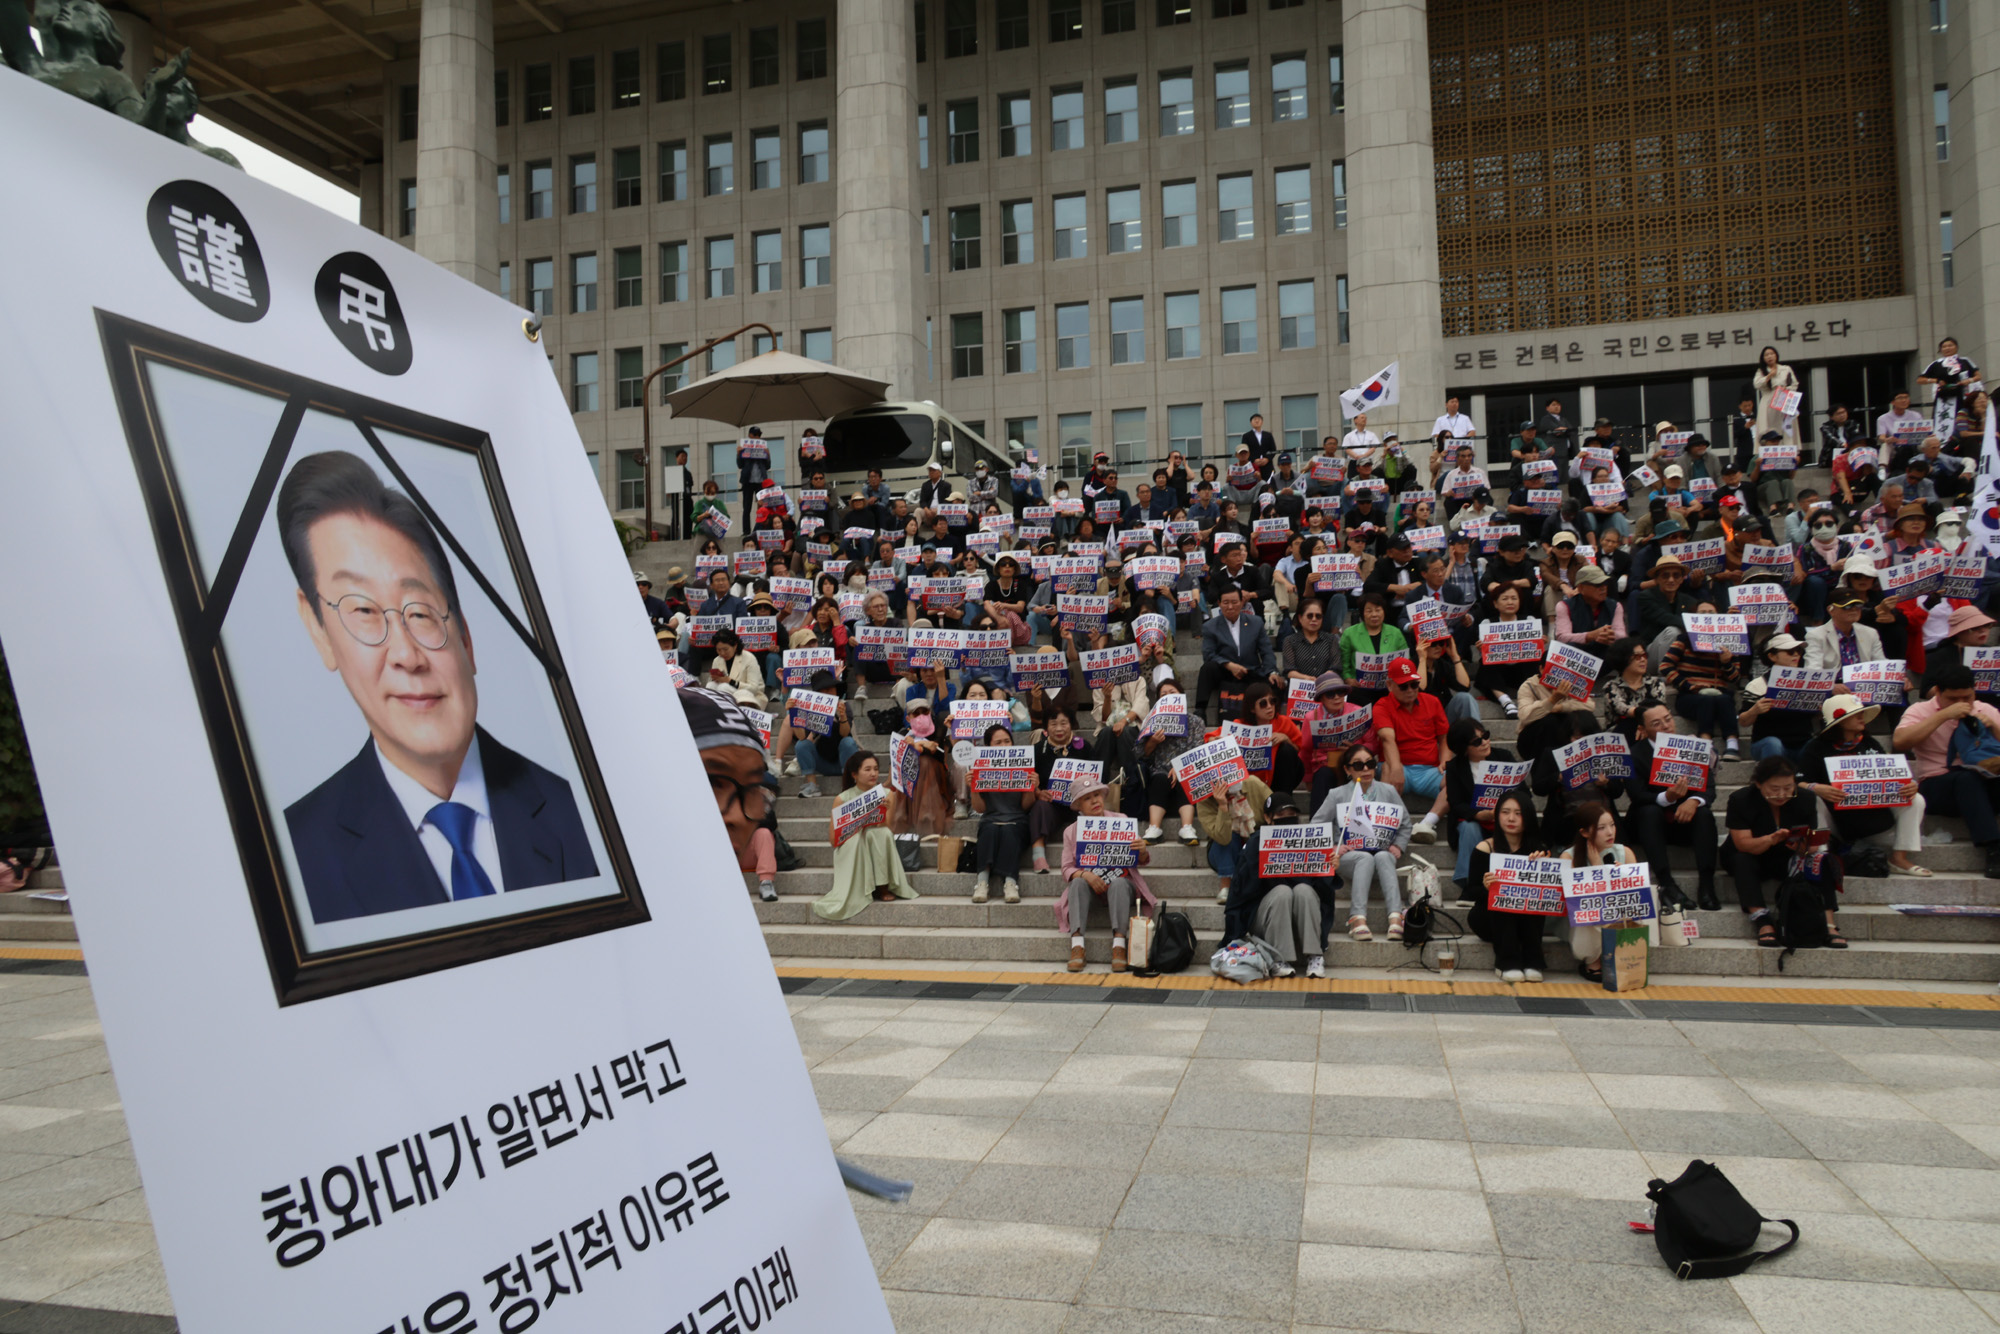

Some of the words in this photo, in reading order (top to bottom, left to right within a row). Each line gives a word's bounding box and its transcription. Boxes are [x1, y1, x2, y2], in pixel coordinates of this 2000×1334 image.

[168, 204, 258, 307] 謹
[339, 271, 396, 353] 弔
[1454, 350, 1497, 370] 모든
[1516, 342, 1584, 366] 권력은
[1604, 328, 1753, 358] 국민으로부터
[1774, 319, 1851, 343] 나온다
[1488, 623, 1517, 633] 피하지
[1518, 622, 1532, 630] 말고
[912, 638, 934, 646] 진실을
[936, 639, 958, 647] 밝혀라
[1482, 633, 1499, 642] 재판
[1500, 632, 1516, 640] 부터
[1517, 629, 1540, 639] 받아라
[915, 649, 928, 657] 518
[930, 649, 953, 658] 유공자
[1488, 642, 1520, 652] 국민합의
[1521, 641, 1536, 650] 없는
[910, 657, 925, 666] 전면
[980, 657, 1007, 666] 공개하라
[1485, 652, 1509, 662] 개헌은
[1509, 650, 1541, 660] 반대한다
[1558, 646, 1582, 662] 피하지
[1580, 655, 1595, 668] 말고
[1549, 653, 1566, 666] 재판
[1564, 659, 1580, 672] 부터
[1577, 664, 1597, 679] 받아라
[1548, 665, 1576, 684] 국민합의
[1574, 676, 1588, 689] 없는
[954, 728, 972, 736] 전면
[980, 749, 1006, 758] 피하지
[1008, 749, 1024, 757] 말고
[1180, 748, 1207, 766] 피하지
[1206, 740, 1226, 755] 말고
[1564, 746, 1592, 767] 진실을
[1595, 744, 1626, 755] 밝혀라
[973, 758, 989, 767] 재판
[991, 758, 1007, 767] 부터
[1008, 758, 1032, 766] 받아라
[1178, 765, 1196, 778] 재판
[1194, 757, 1213, 772] 부터
[1211, 746, 1238, 764] 받아라
[1573, 762, 1591, 776] 518
[1592, 757, 1623, 770] 유공자
[1838, 757, 1872, 769] 피하지
[1875, 756, 1896, 768] 말고
[978, 770, 1010, 779] 국민합의
[1012, 770, 1027, 779] 없는
[1187, 767, 1220, 789] 국민합의
[1218, 759, 1238, 775] 없는
[1483, 772, 1508, 784] 진실을
[1570, 772, 1590, 787] 전면
[1832, 770, 1855, 780] 재판
[1855, 768, 1877, 779] 부터
[1877, 767, 1907, 778] 받아라
[975, 780, 998, 789] 개헌은
[999, 779, 1031, 788] 반대한다
[1841, 782, 1882, 795] 국민합의
[1883, 781, 1903, 792] 없는
[1189, 782, 1214, 801] 개헌은
[1484, 788, 1502, 798] 518
[841, 798, 864, 814] 피하지
[864, 791, 878, 804] 말고
[1478, 798, 1497, 808] 전면
[836, 814, 850, 827] 재판
[851, 806, 867, 820] 부터
[1082, 830, 1107, 840] 진실을
[1111, 830, 1135, 840] 밝혀라
[1272, 827, 1302, 838] 피하지
[1305, 826, 1322, 836] 말고
[1085, 843, 1102, 854] 518
[1104, 844, 1129, 854] 유공자
[1263, 839, 1281, 849] 재판
[1284, 838, 1302, 848] 부터
[1304, 836, 1331, 847] 받아라
[1079, 854, 1097, 864] 전면
[1099, 854, 1135, 865] 공개하라
[1267, 851, 1304, 863] 국민합의
[1306, 850, 1325, 861] 없는
[1263, 863, 1290, 875] 개헌은
[1292, 861, 1329, 873] 반대한다
[1503, 858, 1538, 871] 피하지
[1540, 861, 1561, 873] 말고
[1494, 869, 1516, 881] 재판
[1517, 871, 1537, 883] 부터
[1498, 884, 1539, 898] 국민합의
[1540, 887, 1562, 900] 없는
[1570, 880, 1608, 895] 진실을
[1610, 875, 1645, 890] 밝혀라
[1493, 895, 1523, 910] 개헌은
[1524, 898, 1565, 913] 반대한다
[1579, 896, 1604, 910] 518
[1604, 892, 1640, 907] 유공자
[1573, 909, 1601, 923] 전면
[1601, 903, 1651, 919] 공개하라
[260, 1116, 487, 1268] 청와대가
[487, 1064, 615, 1169] 알면서
[610, 1038, 687, 1107] 막고
[483, 1208, 622, 1334] 정치적
[619, 1150, 731, 1252] 이유로
